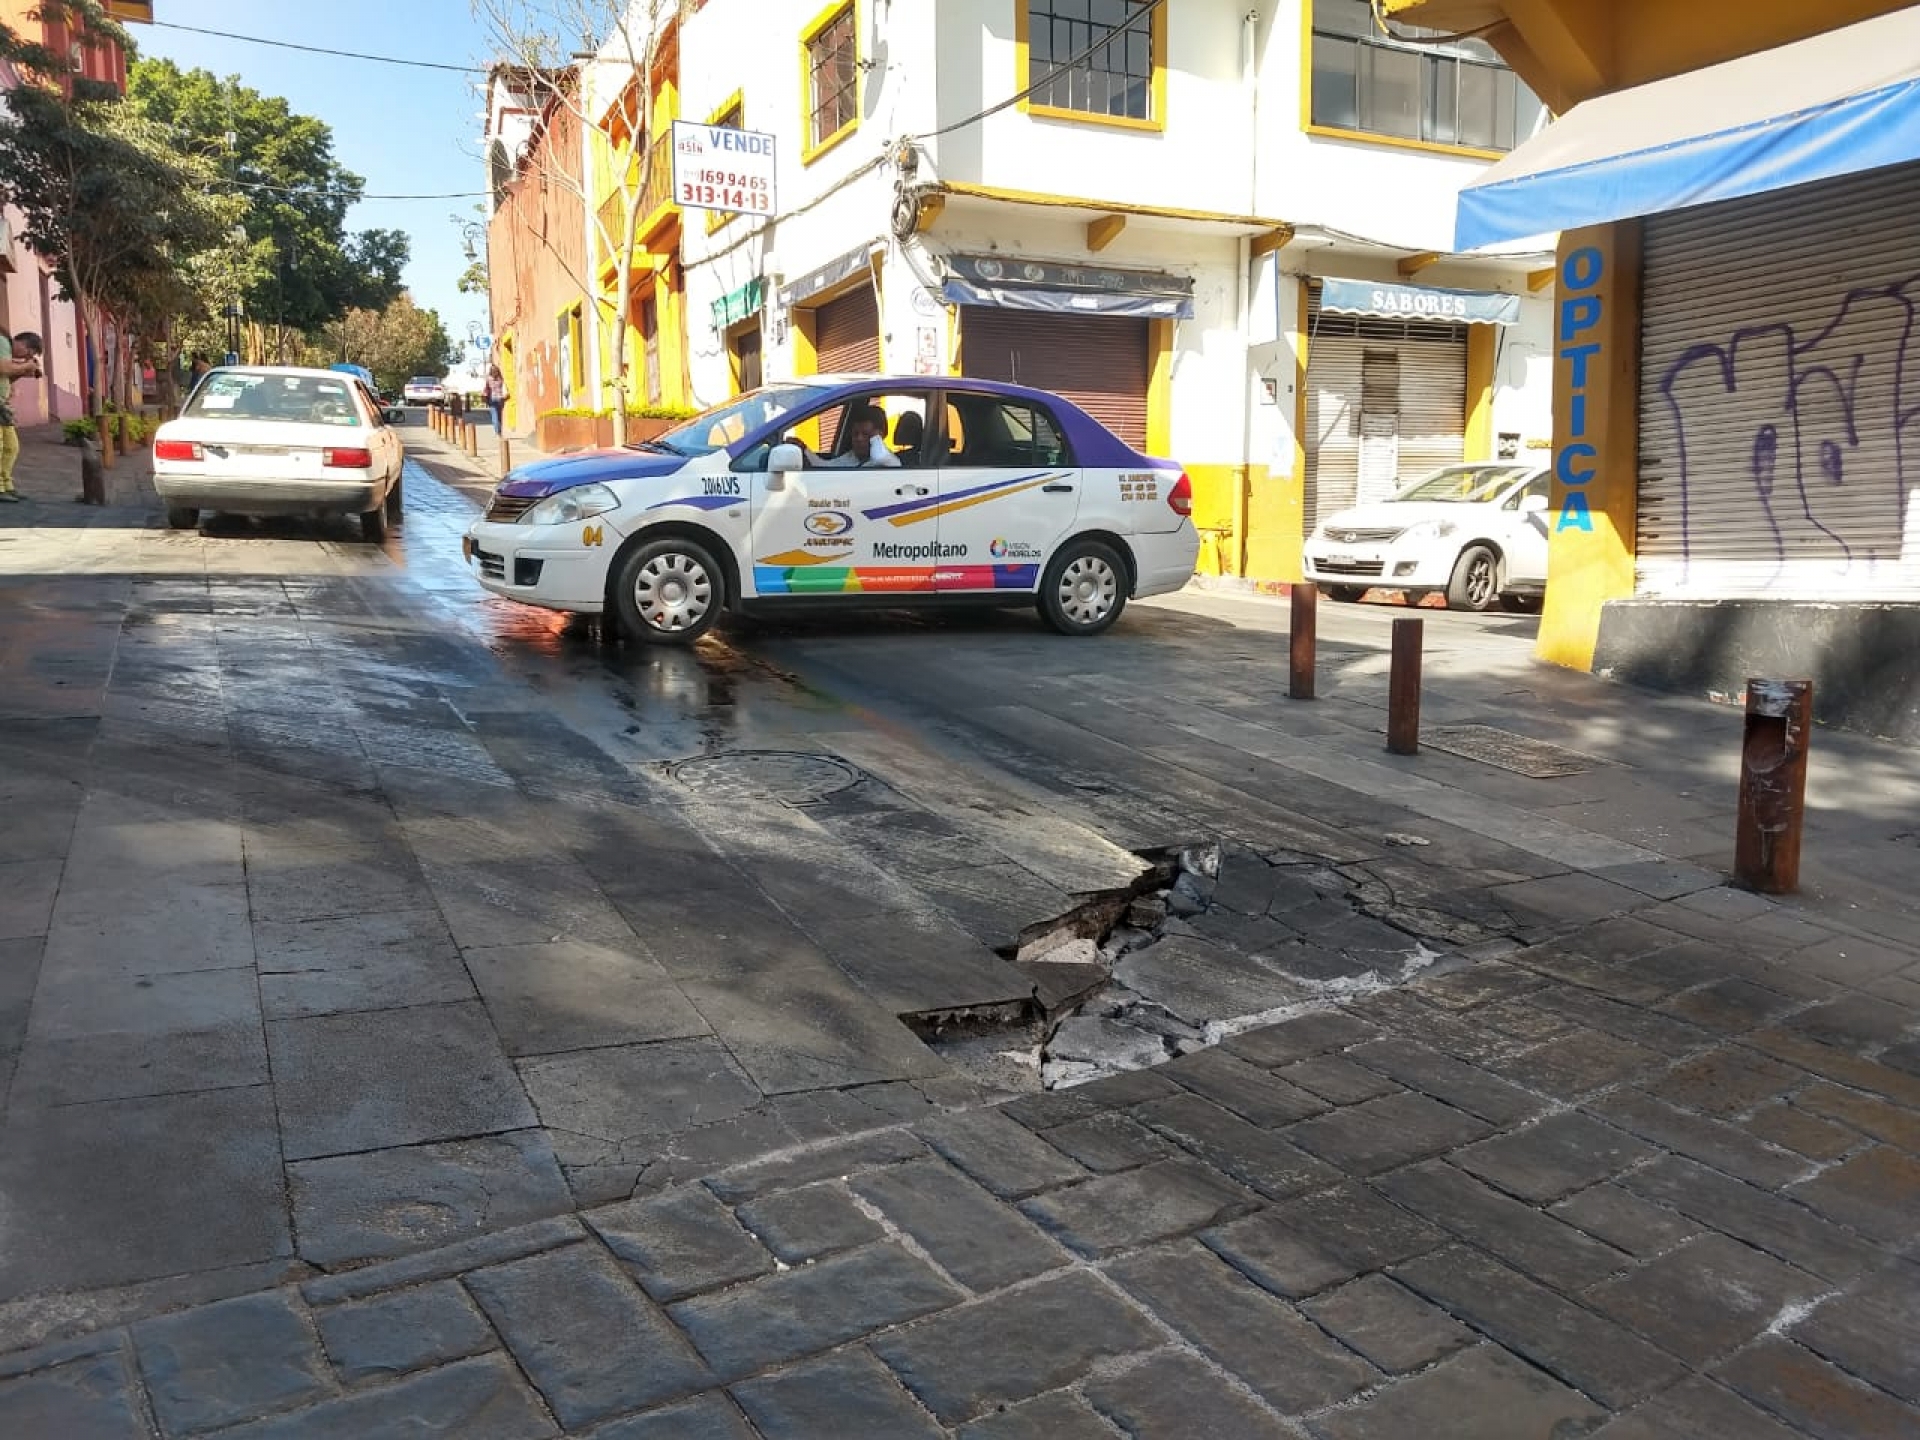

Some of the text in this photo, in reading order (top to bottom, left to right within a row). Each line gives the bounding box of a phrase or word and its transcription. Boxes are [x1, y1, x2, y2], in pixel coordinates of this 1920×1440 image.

[709, 129, 772, 156] VENDE
[1371, 289, 1466, 315] SABORES
[1556, 246, 1604, 532] OPTICA
[582, 526, 604, 547] 04
[872, 541, 968, 561] Metropolitano
